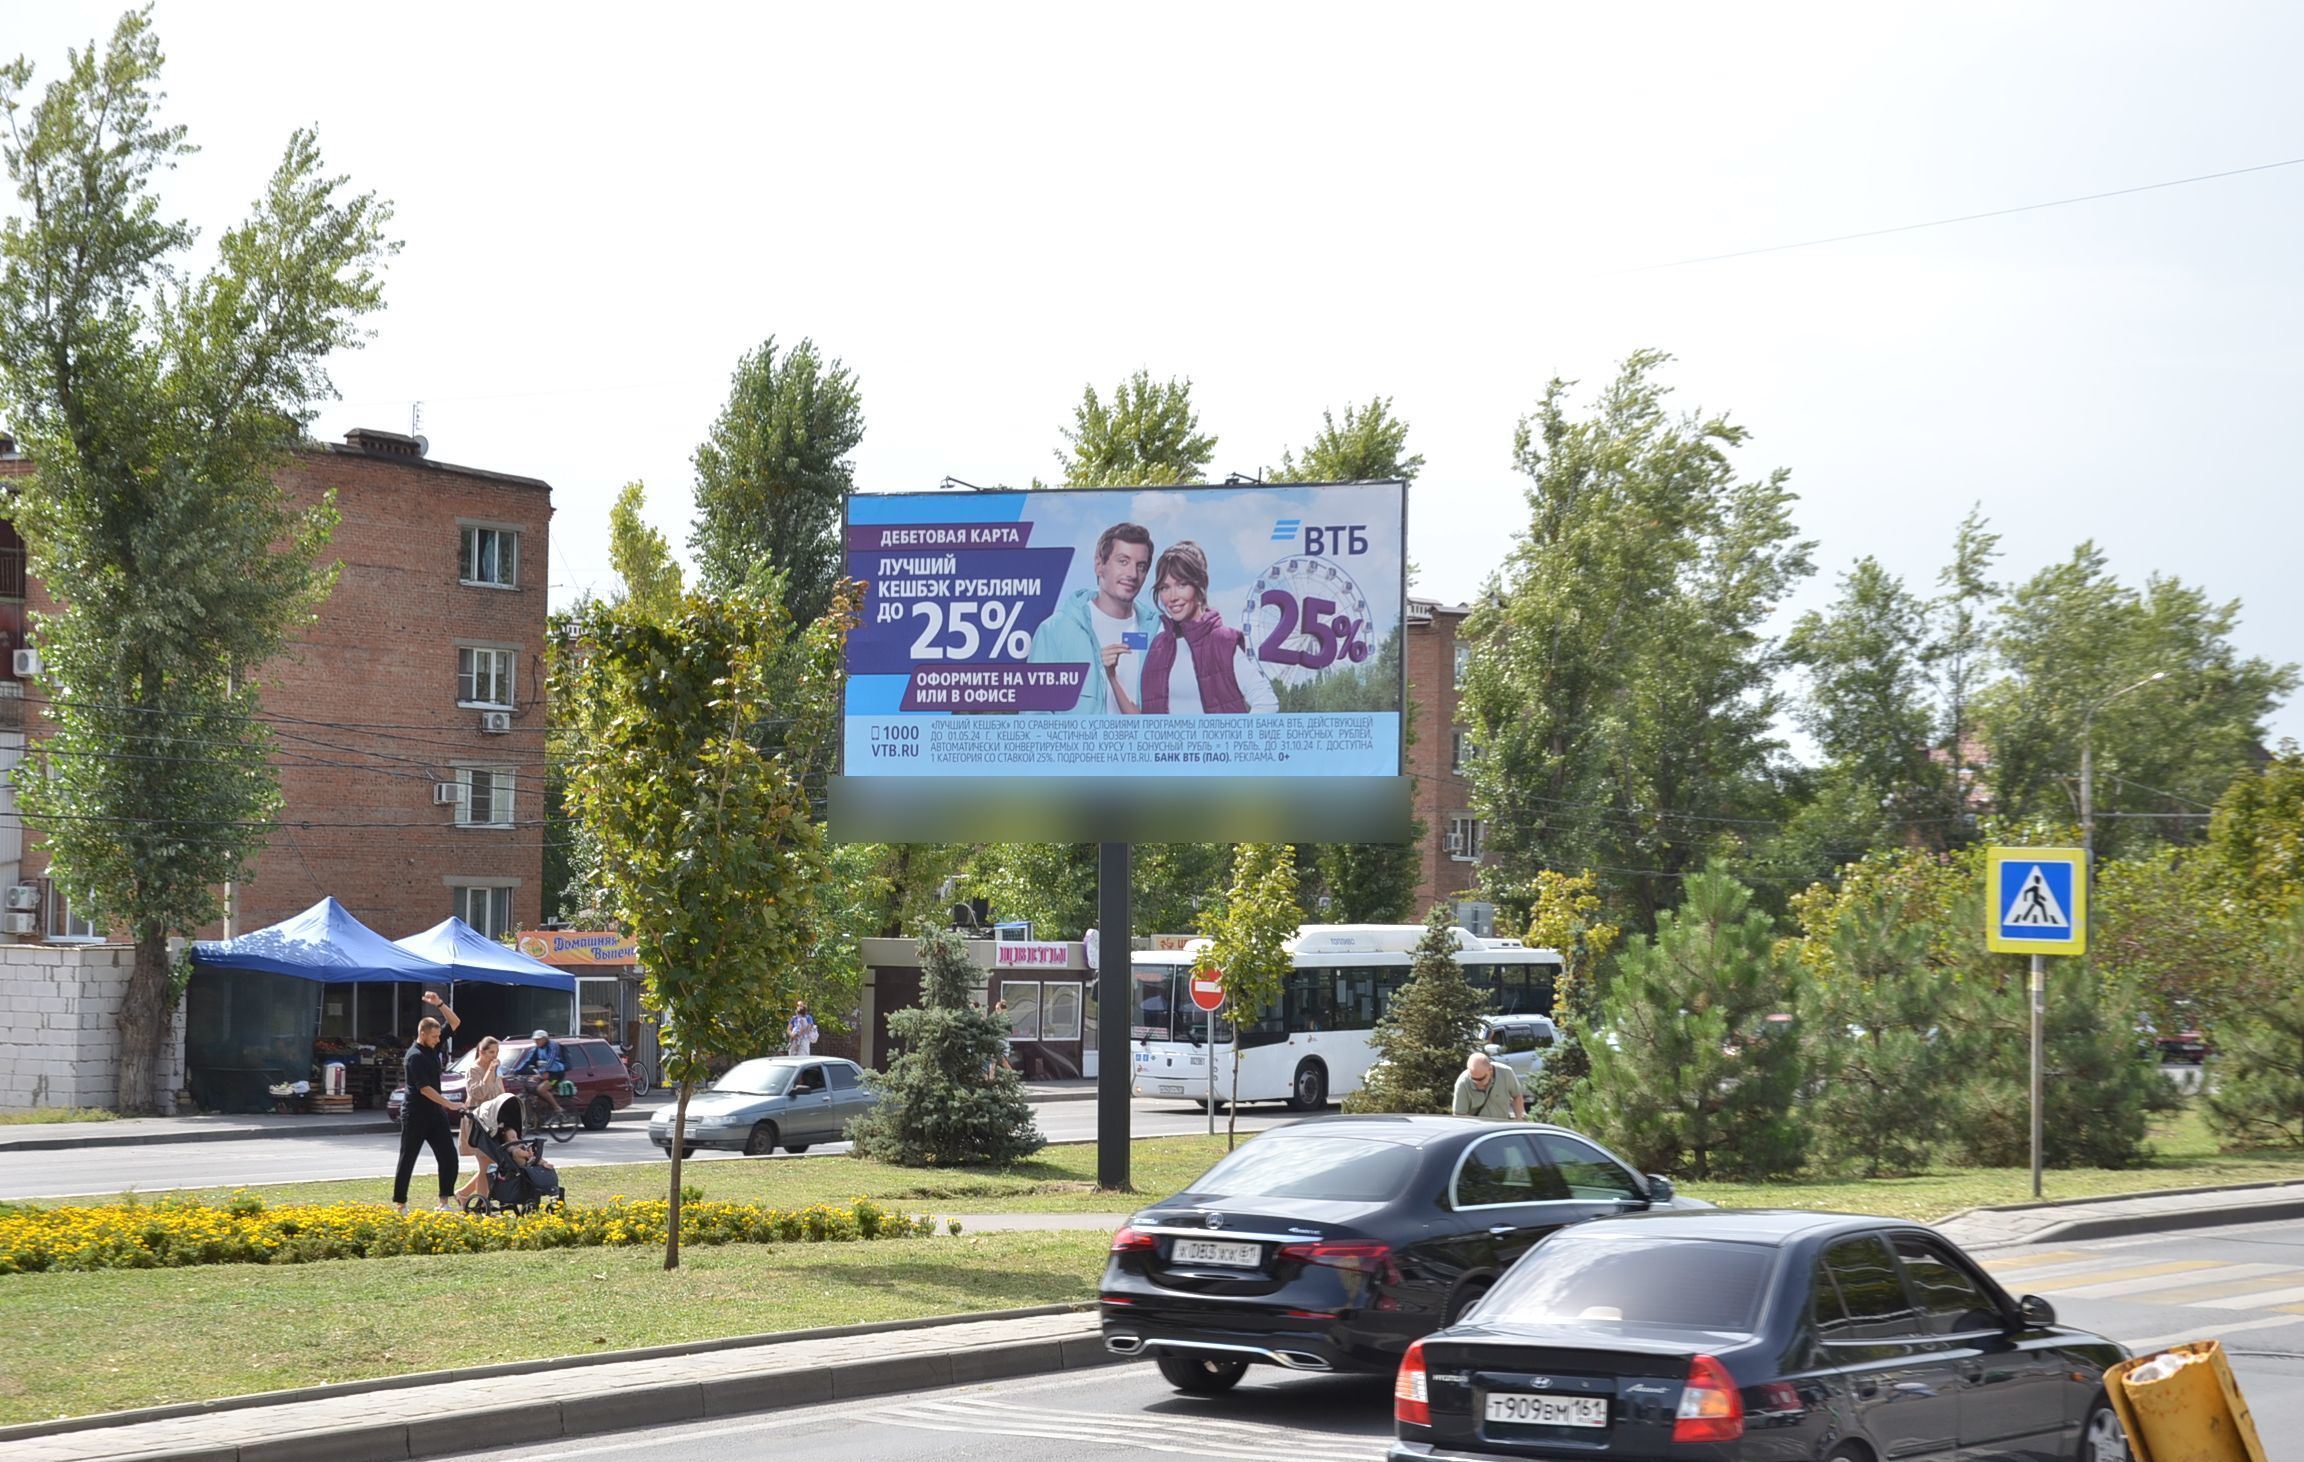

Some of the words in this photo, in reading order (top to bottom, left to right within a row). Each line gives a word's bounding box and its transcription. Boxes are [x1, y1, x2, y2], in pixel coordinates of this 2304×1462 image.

[881, 529, 966, 547] ДЕБЕТОВАЯ
[970, 528, 1019, 543] КАРТА
[1304, 525, 1368, 556] ВТБ
[878, 553, 956, 576] ЛУЧШИЙ
[878, 579, 950, 597] КЕШБЭК
[954, 578, 1041, 597] РУБЛЯМИ
[877, 602, 904, 623] ДО
[910, 601, 1032, 660] 25%
[1258, 589, 1368, 669] 25%
[916, 672, 999, 686] ОФОРМИТЕ
[1003, 672, 1023, 686] НА
[1027, 671, 1079, 686] VTB.RU
[916, 689, 947, 703] ИЛИ
[951, 689, 960, 703] В
[964, 688, 1016, 703] ОФИСЕ
[1013, 720, 1025, 730] ПО
[1028, 719, 1078, 730] СРАВНЕНИЮ
[1081, 719, 1086, 730] С
[1089, 719, 1140, 730] УСЛОВИЯМИ
[1142, 719, 1195, 730] ПРОГРАММЫ
[1199, 719, 1253, 729] ЛОЯЛЬНОСТИ
[1256, 718, 1285, 729] БАНКА
[1307, 716, 1373, 730] ДЕЙСТВУЮЩЕЙ
[883, 725, 919, 740] 1000
[930, 731, 943, 742] ДО
[948, 731, 980, 741] 01.05.24
[997, 731, 1031, 740] КЕШБЭК
[1046, 730, 1098, 740] ЧАСТИЧНЫЙ
[1103, 730, 1138, 740] ВОЗВРАТ
[1144, 730, 1197, 740] СТОИМОСТИ
[1202, 730, 1242, 740] ПОКУПКИ
[1247, 730, 1253, 739] В
[1259, 730, 1281, 740] ВИДЕ
[1286, 730, 1334, 739] БОНУСНЫХ
[871, 744, 919, 757] VTB.RU
[930, 742, 1000, 752] АВТОМАТИЧЕСКИ
[1004, 742, 1078, 751] КОНВЕРТИРУЕМЫХ
[1083, 742, 1095, 751] ПО
[1099, 742, 1124, 751] КУРСУ
[1129, 742, 1133, 751] 1
[1137, 740, 1183, 751] БОНУСНЫЙ
[1187, 742, 1212, 751] РУБЛЬ
[1225, 741, 1229, 750] 1
[1264, 741, 1277, 751] ДО
[1281, 741, 1313, 750] 31.10.24
[1326, 740, 1373, 751] ДОСТУПНА
[931, 753, 935, 762] 1
[937, 753, 983, 762] КАТЕГОРИЯ
[984, 753, 996, 762] СО
[998, 751, 1035, 762] СТАВКОЙ
[1057, 753, 1105, 763] ПОДРОБНЕЕ
[1107, 753, 1119, 762] НА
[1154, 753, 1180, 762] БАНК
[1183, 753, 1200, 762] ВТБ
[1203, 752, 1232, 763] (ПАО).
[1278, 752, 1290, 761] 0+
[554, 936, 618, 952] Домашняя
[591, 946, 635, 960] Выпеч
[999, 947, 1067, 966] ЦВЕТЫ
